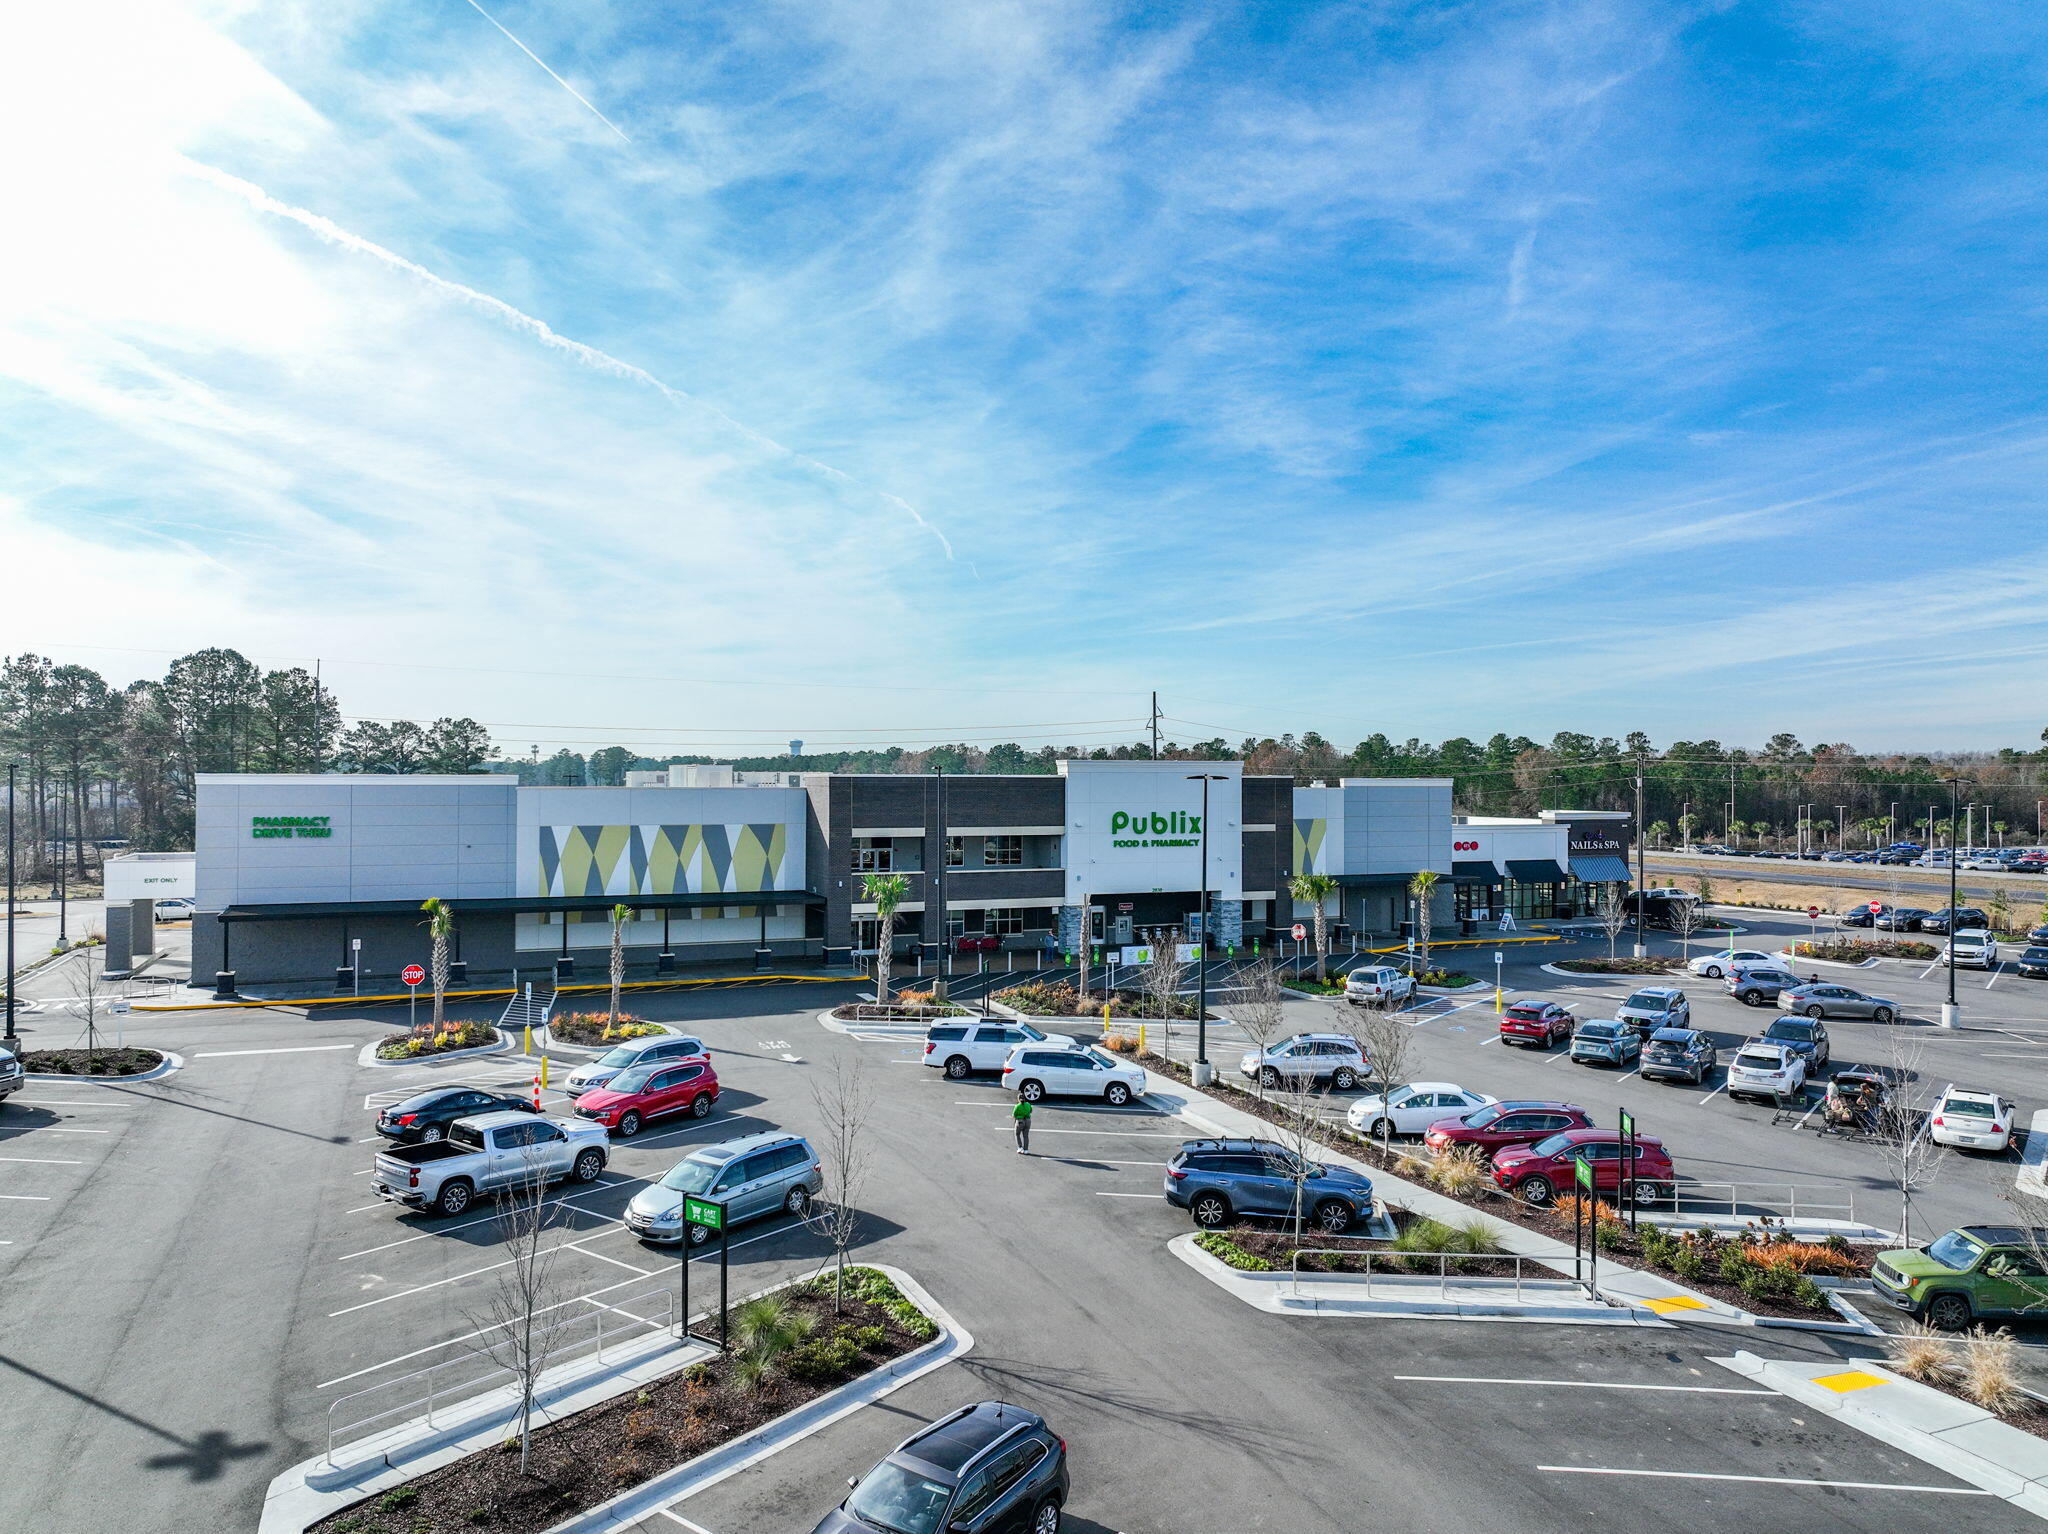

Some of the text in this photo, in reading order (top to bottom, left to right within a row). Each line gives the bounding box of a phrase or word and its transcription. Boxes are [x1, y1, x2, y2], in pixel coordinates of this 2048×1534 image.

[253, 817, 330, 826] PHARMACY
[1112, 811, 1201, 834] Publix
[253, 828, 331, 838] DRIVE THRU
[1113, 840, 1140, 848] FOOD
[1151, 839, 1200, 847] PHARMACY
[1571, 841, 1598, 850] NAILS
[1604, 841, 1620, 849] SPA
[404, 971, 423, 979] STOP
